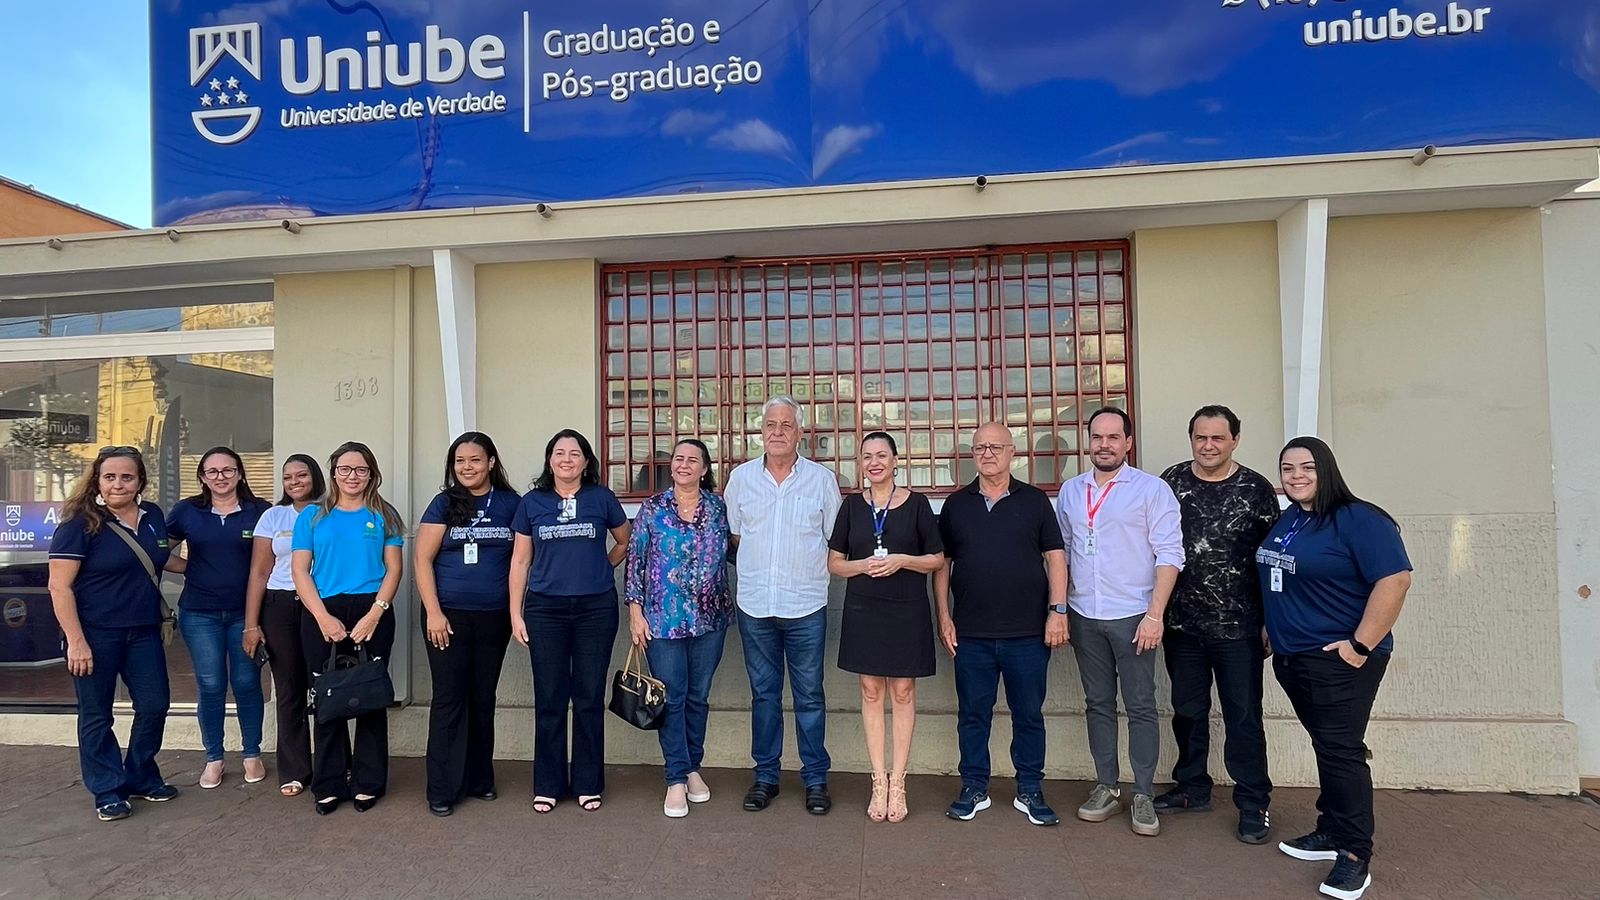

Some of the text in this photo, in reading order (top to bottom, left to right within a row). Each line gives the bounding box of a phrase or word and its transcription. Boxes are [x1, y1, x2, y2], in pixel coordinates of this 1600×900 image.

[543, 17, 721, 57] Graduação e
[1303, 2, 1491, 46] uniube.br
[280, 25, 506, 95] Uniube
[542, 55, 763, 102] Pós-graduação
[280, 91, 508, 129] Universidade de Verdade
[0, 529, 35, 541] niube
